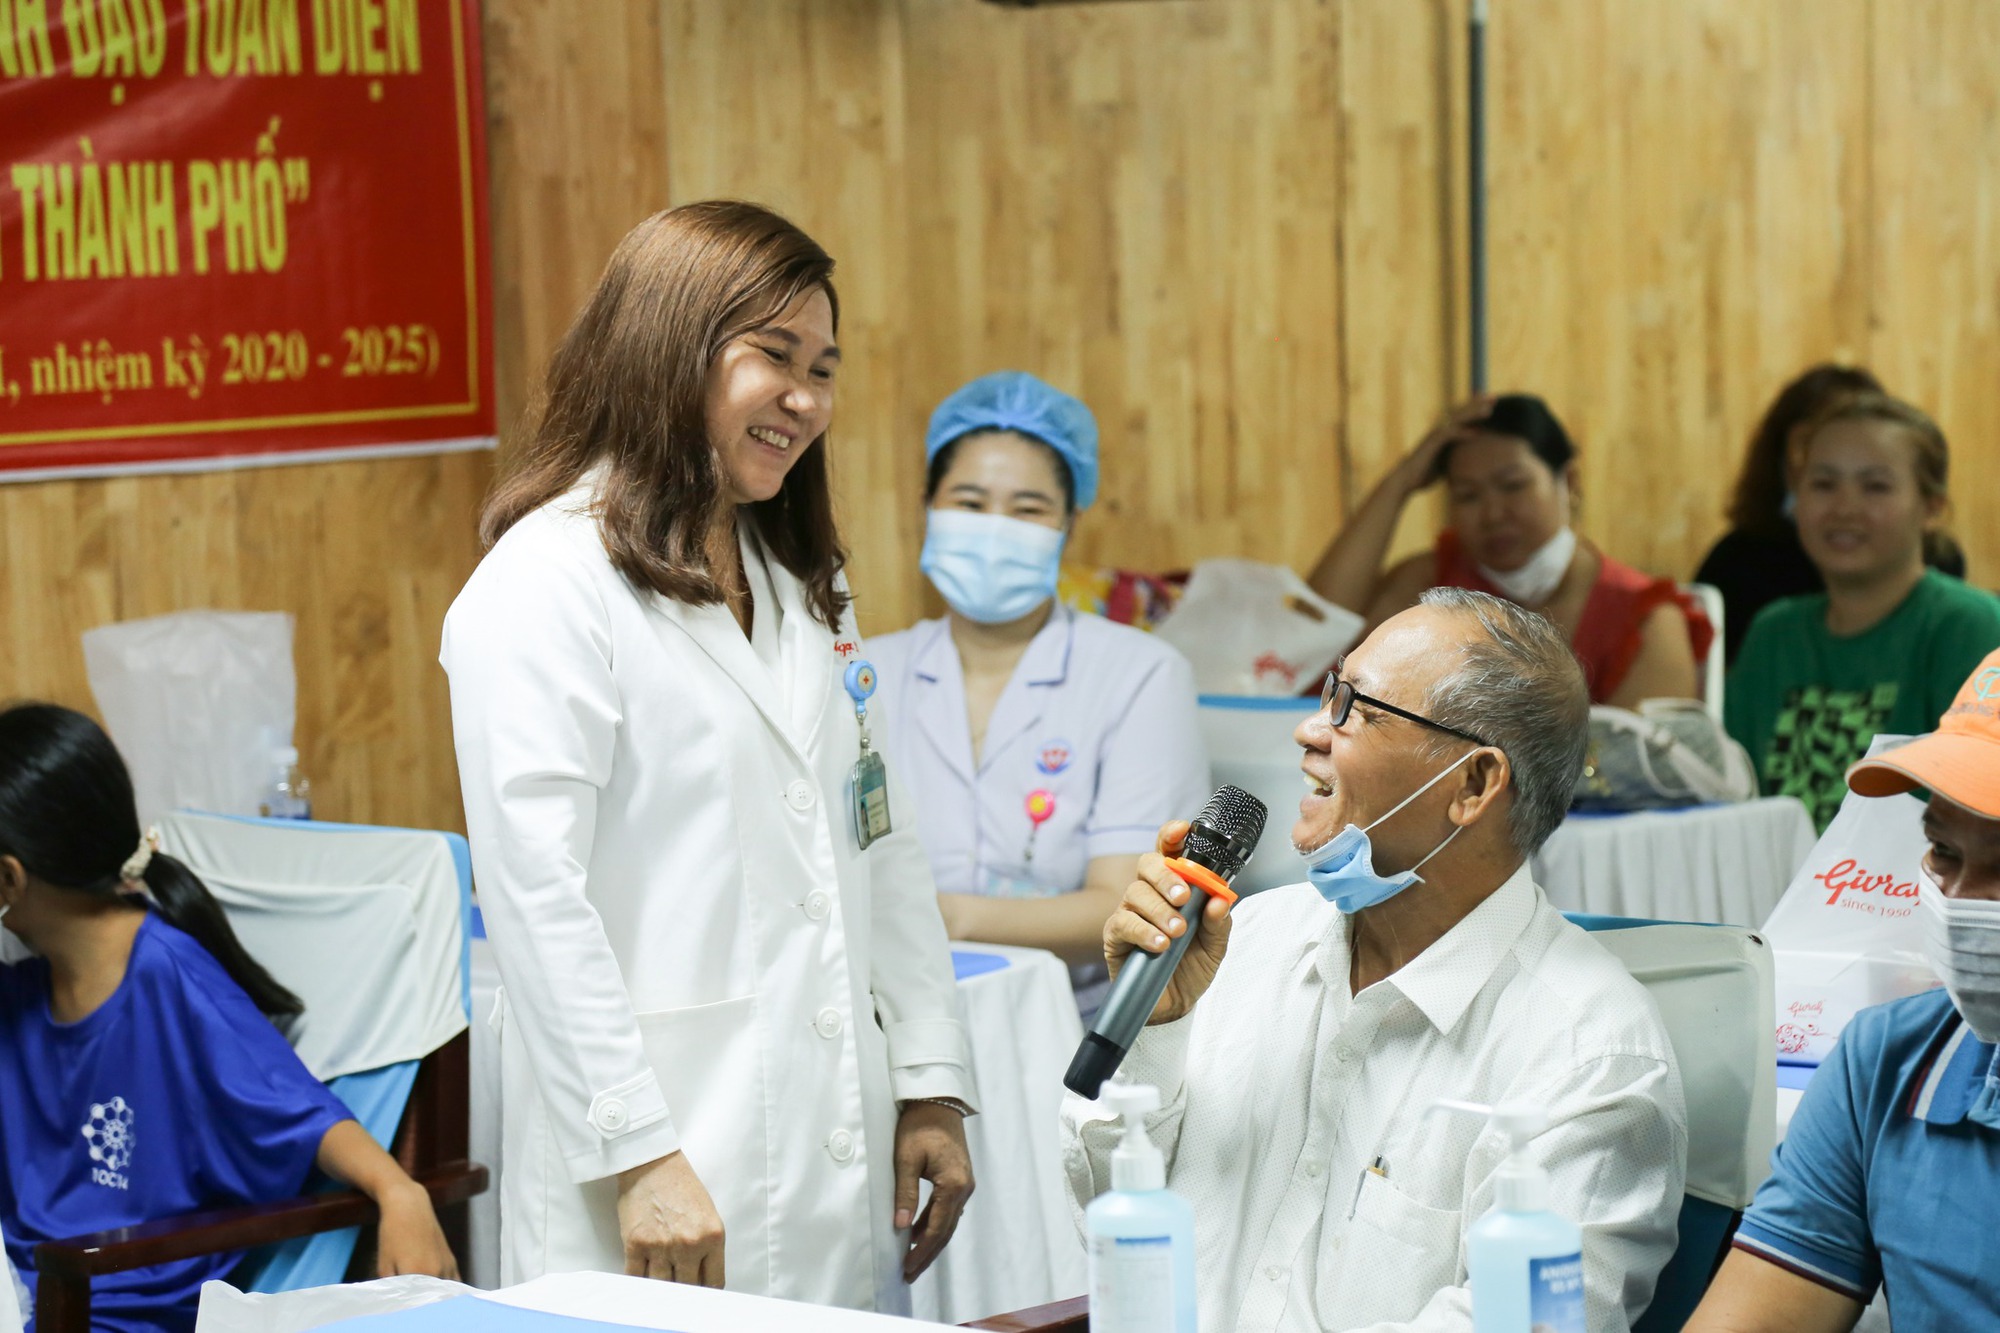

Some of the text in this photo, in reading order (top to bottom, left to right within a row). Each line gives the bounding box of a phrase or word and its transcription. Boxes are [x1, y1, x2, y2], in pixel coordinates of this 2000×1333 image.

[11, 135, 179, 281] THÀNH
[31, 337, 152, 405] nhiệm
[162, 334, 209, 400] kỳ
[221, 331, 309, 383] 2020
[341, 323, 440, 381] 2025)
[1841, 897, 1911, 917] since 1950
